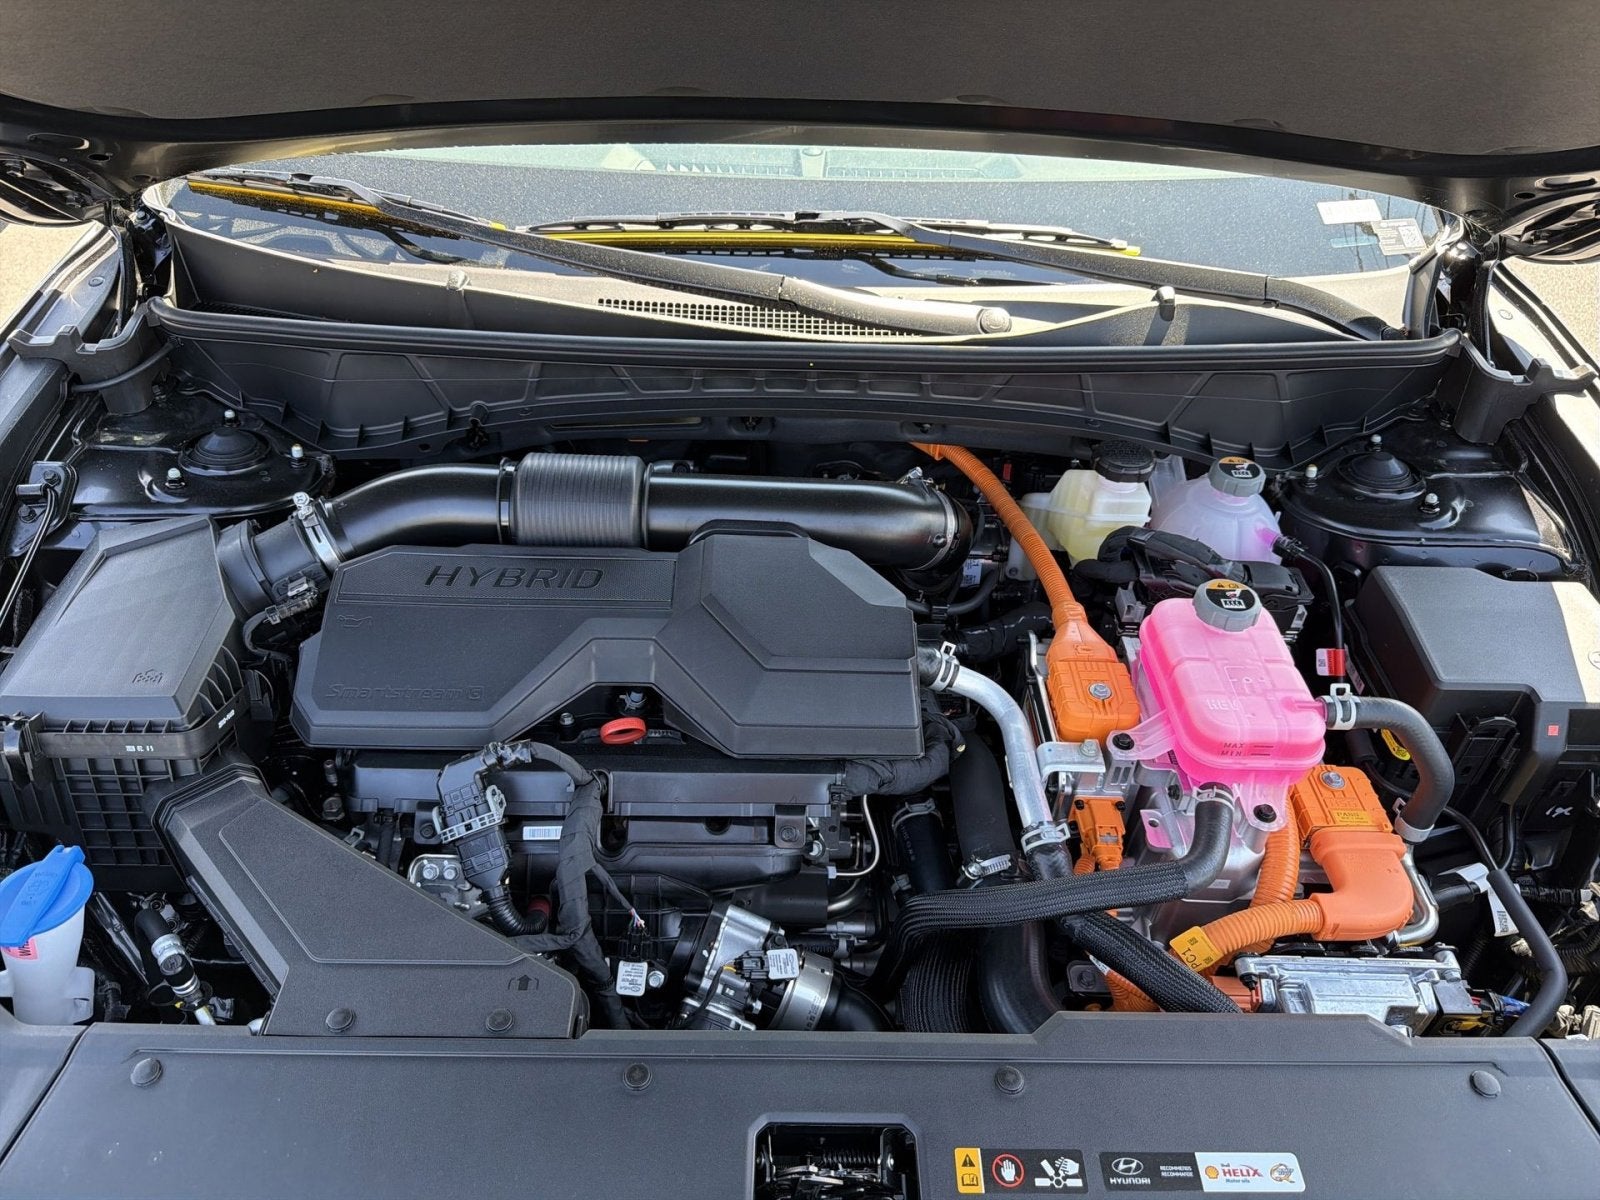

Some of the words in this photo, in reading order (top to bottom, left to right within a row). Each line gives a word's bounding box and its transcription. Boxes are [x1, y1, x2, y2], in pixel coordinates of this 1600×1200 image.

[424, 565, 604, 589] HYBRID
[326, 684, 462, 699] Smartstream
[1182, 947, 1202, 969] PC1
[1222, 1168, 1263, 1177] HELIX
[1109, 1177, 1151, 1185] HYUNDAI
